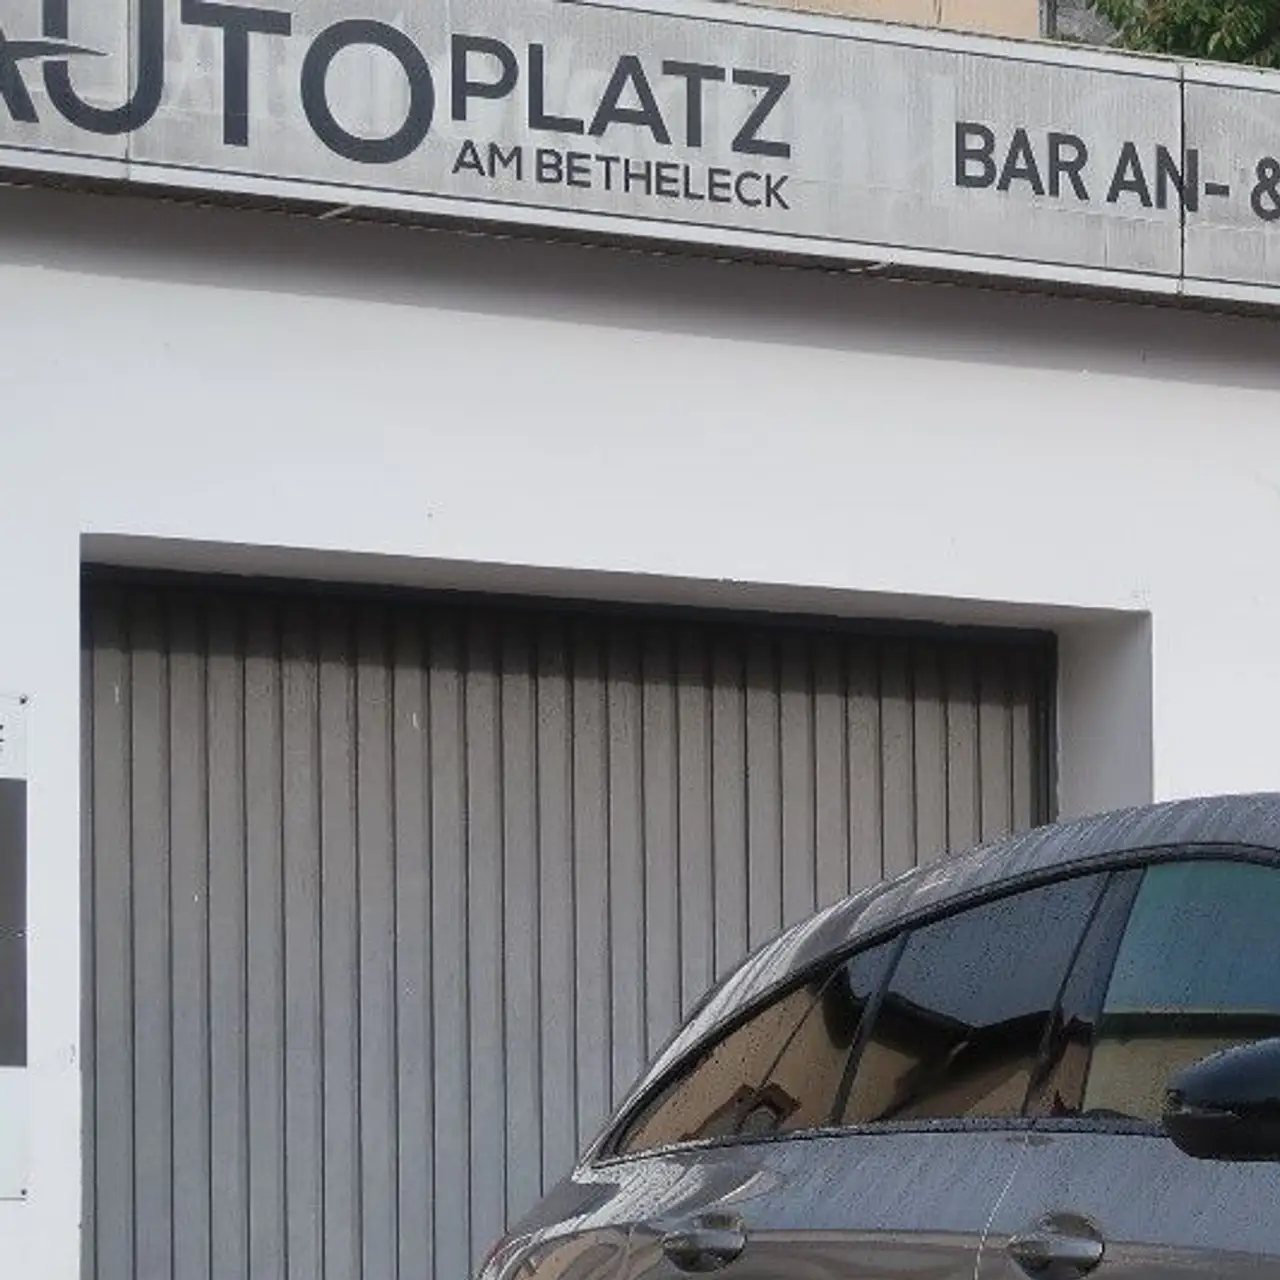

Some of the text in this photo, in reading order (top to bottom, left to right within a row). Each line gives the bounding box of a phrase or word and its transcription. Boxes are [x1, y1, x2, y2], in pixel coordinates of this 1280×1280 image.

[450, 139, 791, 211] AM BETHELECK
[954, 120, 1090, 201] BAR
